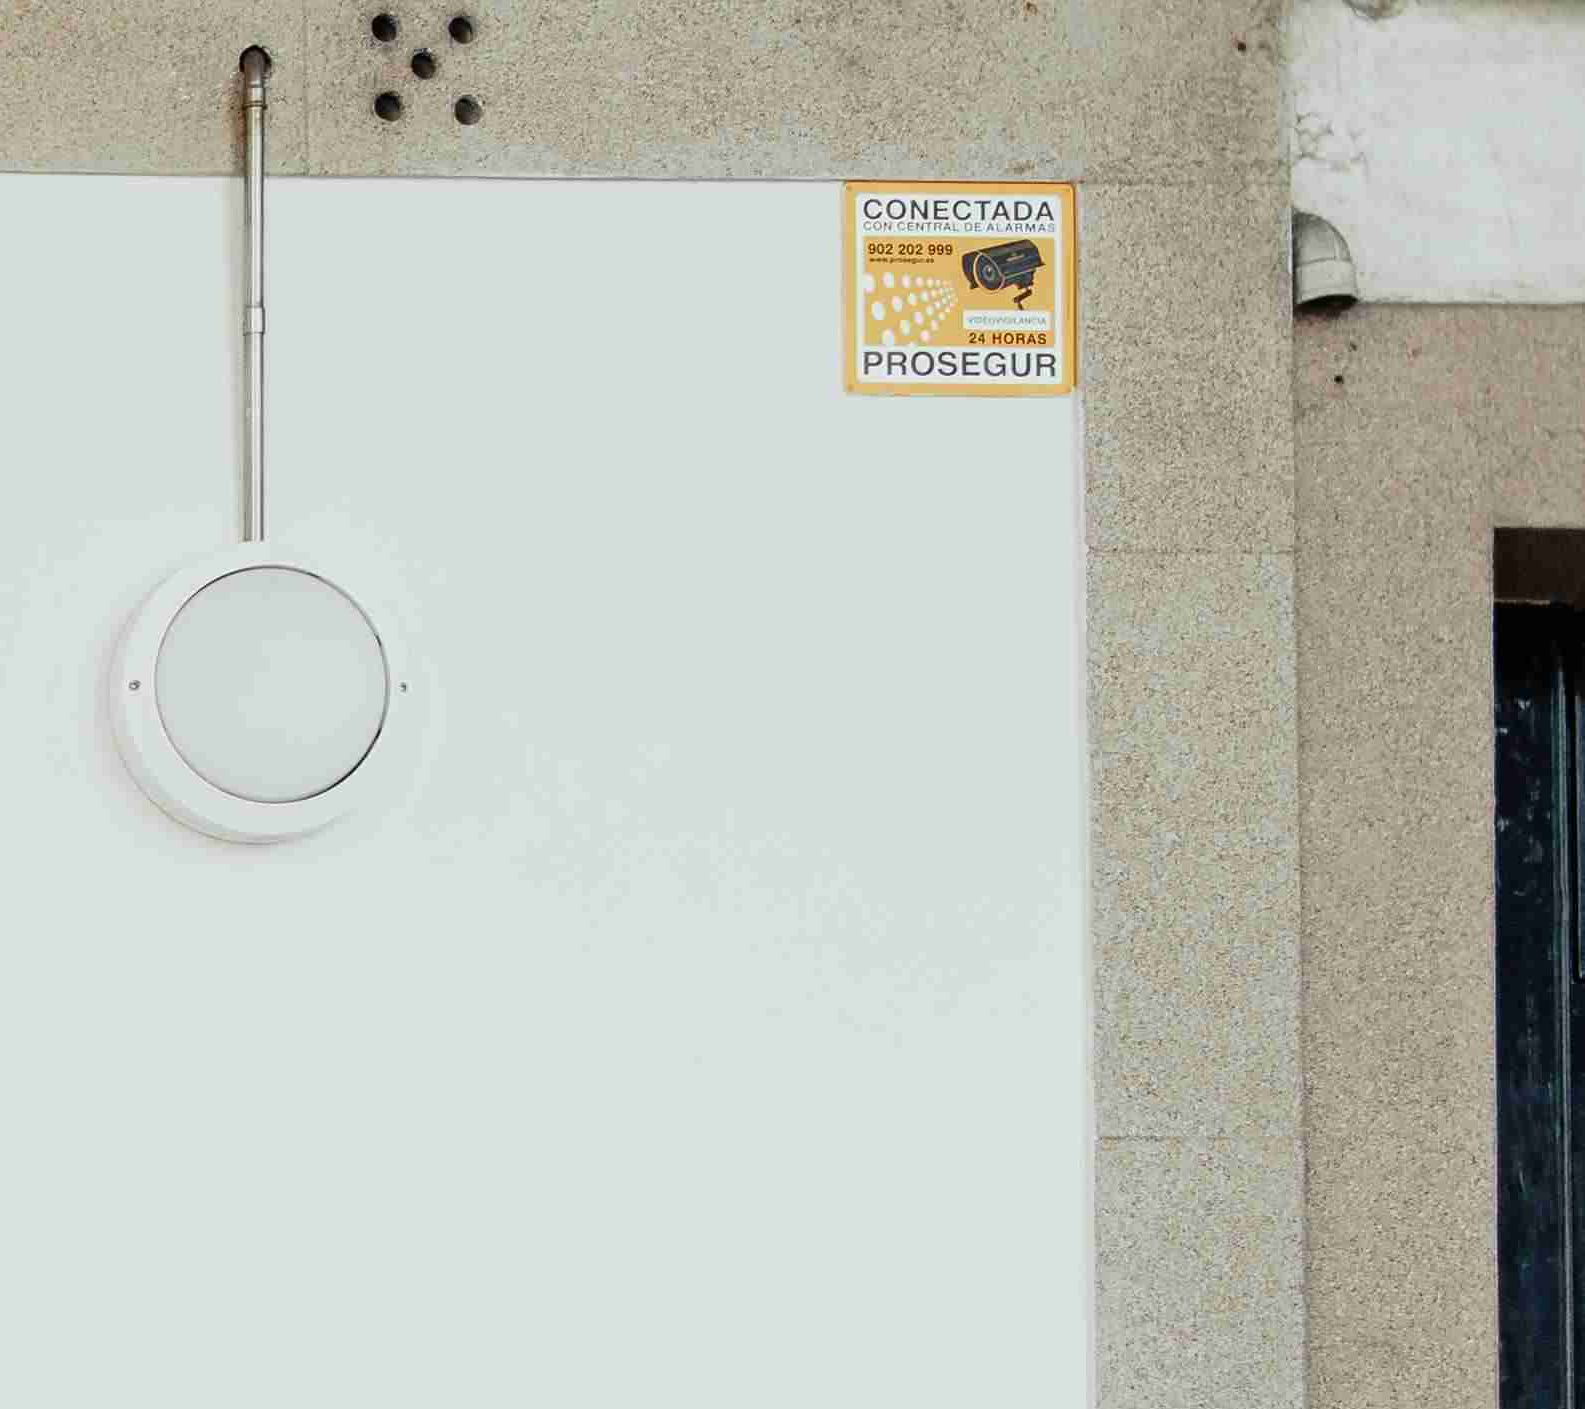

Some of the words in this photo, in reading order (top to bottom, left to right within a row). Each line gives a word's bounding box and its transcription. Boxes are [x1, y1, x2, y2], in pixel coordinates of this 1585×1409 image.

[863, 199, 1055, 221] CONECTADA
[863, 221, 892, 232] CON
[897, 221, 959, 232] CENTRAL
[964, 222, 982, 232] DE
[984, 222, 1055, 233] ALARMAS
[868, 243, 893, 255] 902
[898, 243, 924, 255] 202
[928, 243, 953, 256] 999
[969, 332, 986, 344] 24
[992, 332, 1047, 345] HORAS
[863, 351, 1057, 378] PROSEGUR
